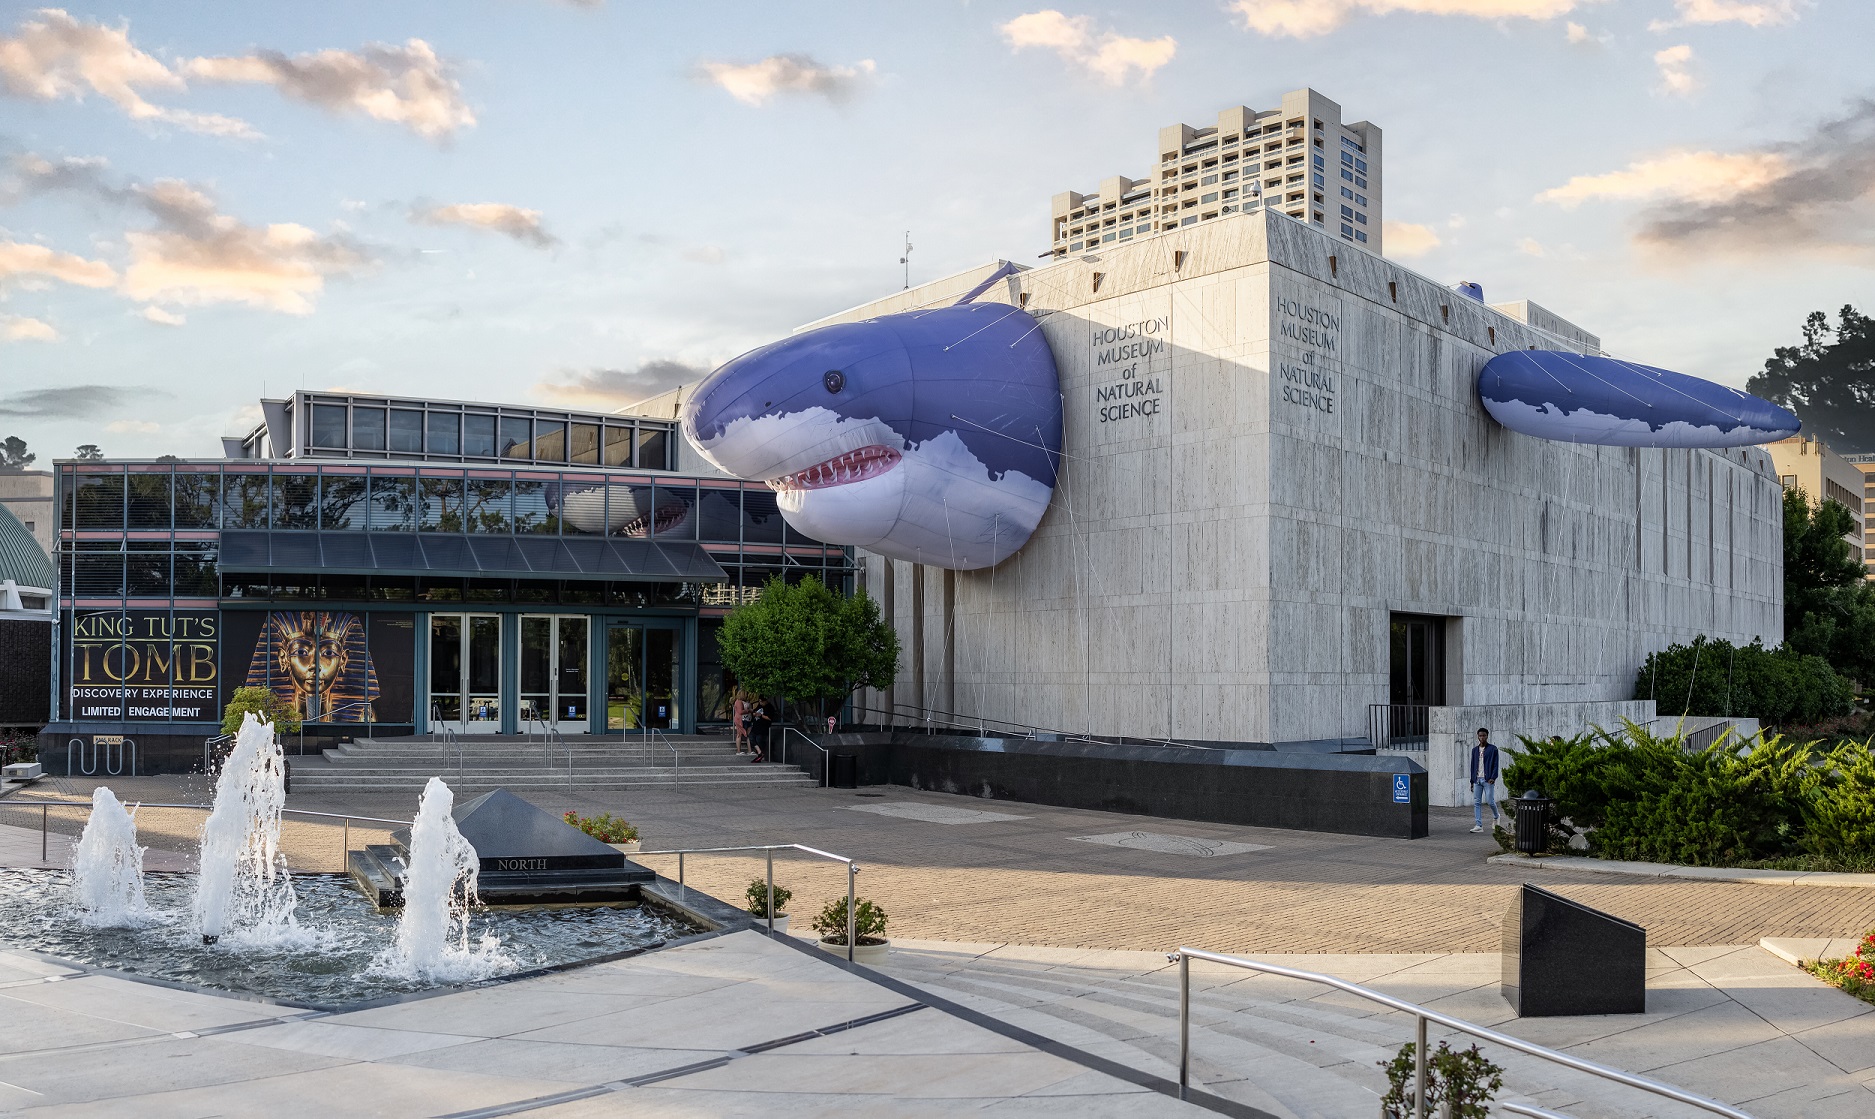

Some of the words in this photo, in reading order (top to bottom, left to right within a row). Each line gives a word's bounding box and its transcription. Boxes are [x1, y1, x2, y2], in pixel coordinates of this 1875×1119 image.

[1277, 296, 1340, 332] HOUSTON
[1092, 315, 1168, 347] HOUSTON
[1280, 320, 1335, 351] MUSEUM
[1097, 338, 1164, 366] MUSEUM
[1302, 350, 1314, 365] of
[1122, 363, 1137, 380] of
[1280, 362, 1335, 394] NATURAL
[1097, 378, 1163, 402] NATURAL
[1282, 385, 1333, 414] SCIENCE
[1100, 398, 1160, 423] SCIENCE
[74, 617, 134, 637] KING
[143, 617, 216, 637] TUT'S
[73, 643, 217, 682] TOMB
[73, 688, 139, 698] DISCOVERY
[142, 689, 213, 699] EXPERIENCE
[81, 706, 121, 716] LIMITED
[128, 706, 201, 717] ENGAGEMENT
[497, 859, 548, 871] NORTH
